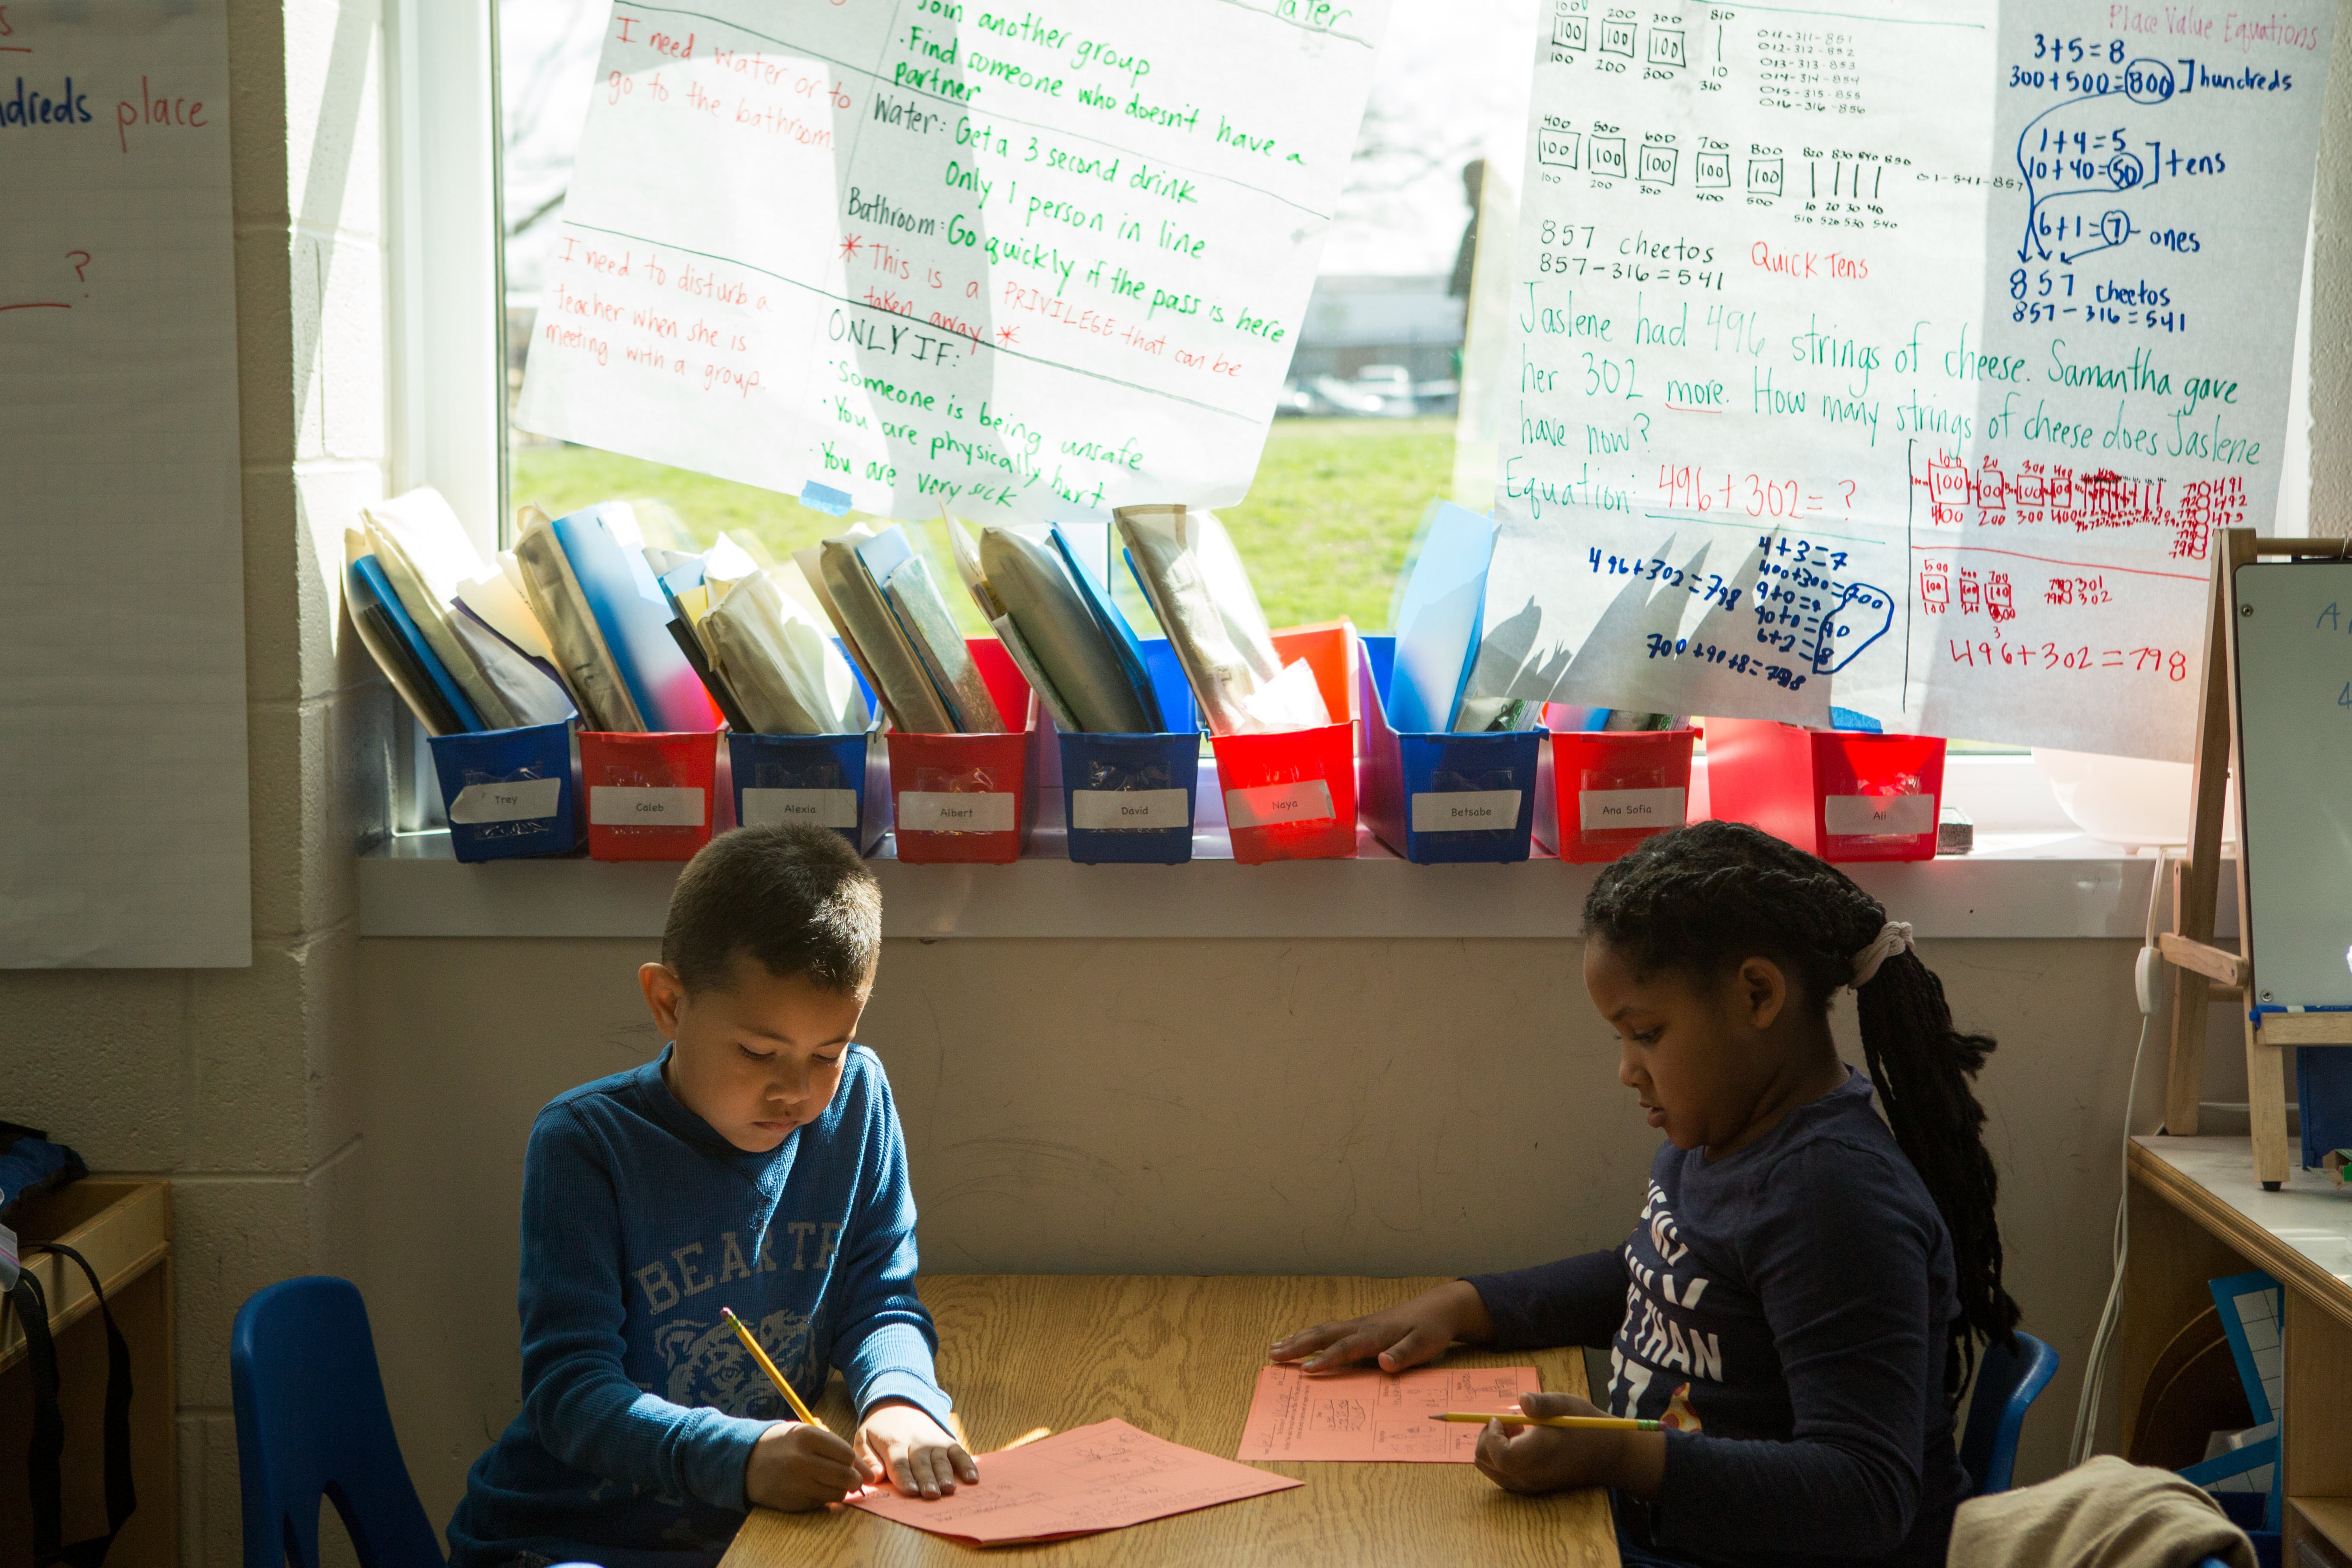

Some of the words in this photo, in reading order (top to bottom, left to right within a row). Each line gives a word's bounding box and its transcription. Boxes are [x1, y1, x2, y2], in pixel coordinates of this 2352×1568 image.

[978, 10, 1067, 50] another
[1071, 38, 1151, 88] group
[2108, 3, 2161, 37] Place
[2164, 6, 2215, 41] Value
[2223, 13, 2321, 56] Equations
[616, 17, 641, 44] I
[649, 32, 695, 61] need
[794, 76, 822, 99] or
[828, 82, 851, 109] to
[893, 61, 982, 104] partner
[2198, 62, 2294, 91] hundreds
[116, 75, 209, 154] place
[608, 70, 634, 106] go
[649, 73, 669, 101] to
[686, 81, 722, 118] the
[908, 25, 958, 67] Find
[967, 49, 1063, 99] someone
[1078, 83, 1117, 111] who
[1124, 94, 1200, 136] doesn't
[1216, 115, 1276, 158] have
[1285, 151, 1307, 167] a
[873, 92, 947, 135] Water:
[955, 117, 991, 147] Get
[996, 138, 1008, 158] a
[1024, 133, 1040, 163] 3
[1046, 144, 1119, 183] second
[1128, 161, 1200, 205] drink
[2164, 148, 2227, 176] tens
[945, 161, 993, 210] Only
[1027, 195, 1104, 239] person
[1117, 210, 1142, 243] in
[1158, 217, 1206, 261] line
[848, 185, 946, 239] Bathroom:
[947, 214, 978, 249] Go
[985, 233, 1076, 298] quickly
[1086, 261, 1102, 287] if
[1110, 267, 1147, 301] the
[1152, 291, 1203, 322] pass
[1207, 299, 1224, 324] is
[1236, 308, 1285, 344] here
[1619, 229, 1715, 263] cheetos
[1751, 241, 1818, 279] Quick
[1828, 251, 1869, 280] Tens
[2149, 228, 2201, 255] ones
[64, 250, 92, 299] ?
[558, 238, 582, 262] I
[586, 251, 630, 277] need
[644, 254, 666, 286] to
[678, 264, 748, 306] disturb
[756, 296, 774, 312] a
[2094, 279, 2171, 307] cheetos
[863, 285, 914, 317] taken
[869, 243, 911, 280] This
[927, 262, 943, 290] is
[966, 281, 979, 300] a
[1004, 281, 1115, 338] PRIVILEGE
[1120, 325, 1168, 357] that
[1174, 348, 1205, 372] can
[1212, 353, 1242, 379] be
[633, 307, 678, 339] when
[687, 319, 719, 348] she
[730, 335, 747, 352] is
[827, 308, 910, 354] ONLY
[913, 335, 961, 368] IF:
[1520, 280, 1612, 344] Jaslene
[1635, 290, 1688, 347] had
[1706, 304, 1767, 356] 496
[1791, 312, 1880, 398] strings
[1895, 320, 1931, 374] of
[1945, 321, 2031, 383] cheese.
[2046, 338, 2173, 397] Samantha
[2183, 376, 2238, 416] gave
[626, 345, 664, 370] with
[674, 359, 686, 375] a
[838, 360, 936, 413] Someone
[947, 395, 966, 422] is
[979, 401, 1043, 457] being
[1061, 436, 1145, 472] unsafe
[1520, 400, 1568, 448] have
[1586, 412, 1652, 455] now?
[1521, 343, 1559, 394] her
[1581, 352, 1644, 400] 302
[1666, 379, 1731, 407] more.
[1754, 366, 1807, 416] How
[1821, 392, 1881, 448] many
[1895, 388, 1973, 461] strings
[1988, 392, 2021, 440] of
[2023, 399, 2094, 449] cheese
[2102, 427, 2159, 457] does
[2166, 410, 2261, 466] Jaslene
[822, 440, 853, 476] You
[866, 460, 897, 488] are
[917, 472, 963, 506] very
[967, 480, 1018, 508] sick
[834, 395, 869, 432] You
[881, 421, 919, 447] are
[930, 430, 1042, 490] physically
[1051, 468, 1108, 510] hurt
[1505, 455, 1637, 520] Equation:
[495, 795, 517, 805] Trey
[636, 803, 664, 812] Caleb
[784, 804, 816, 814] Alexia
[940, 808, 973, 818] Albert
[1121, 806, 1148, 815] David
[1272, 800, 1298, 811] Naya
[1451, 807, 1492, 818] Betsabe
[1602, 806, 1622, 815] Ana
[1626, 805, 1652, 815] Sofia
